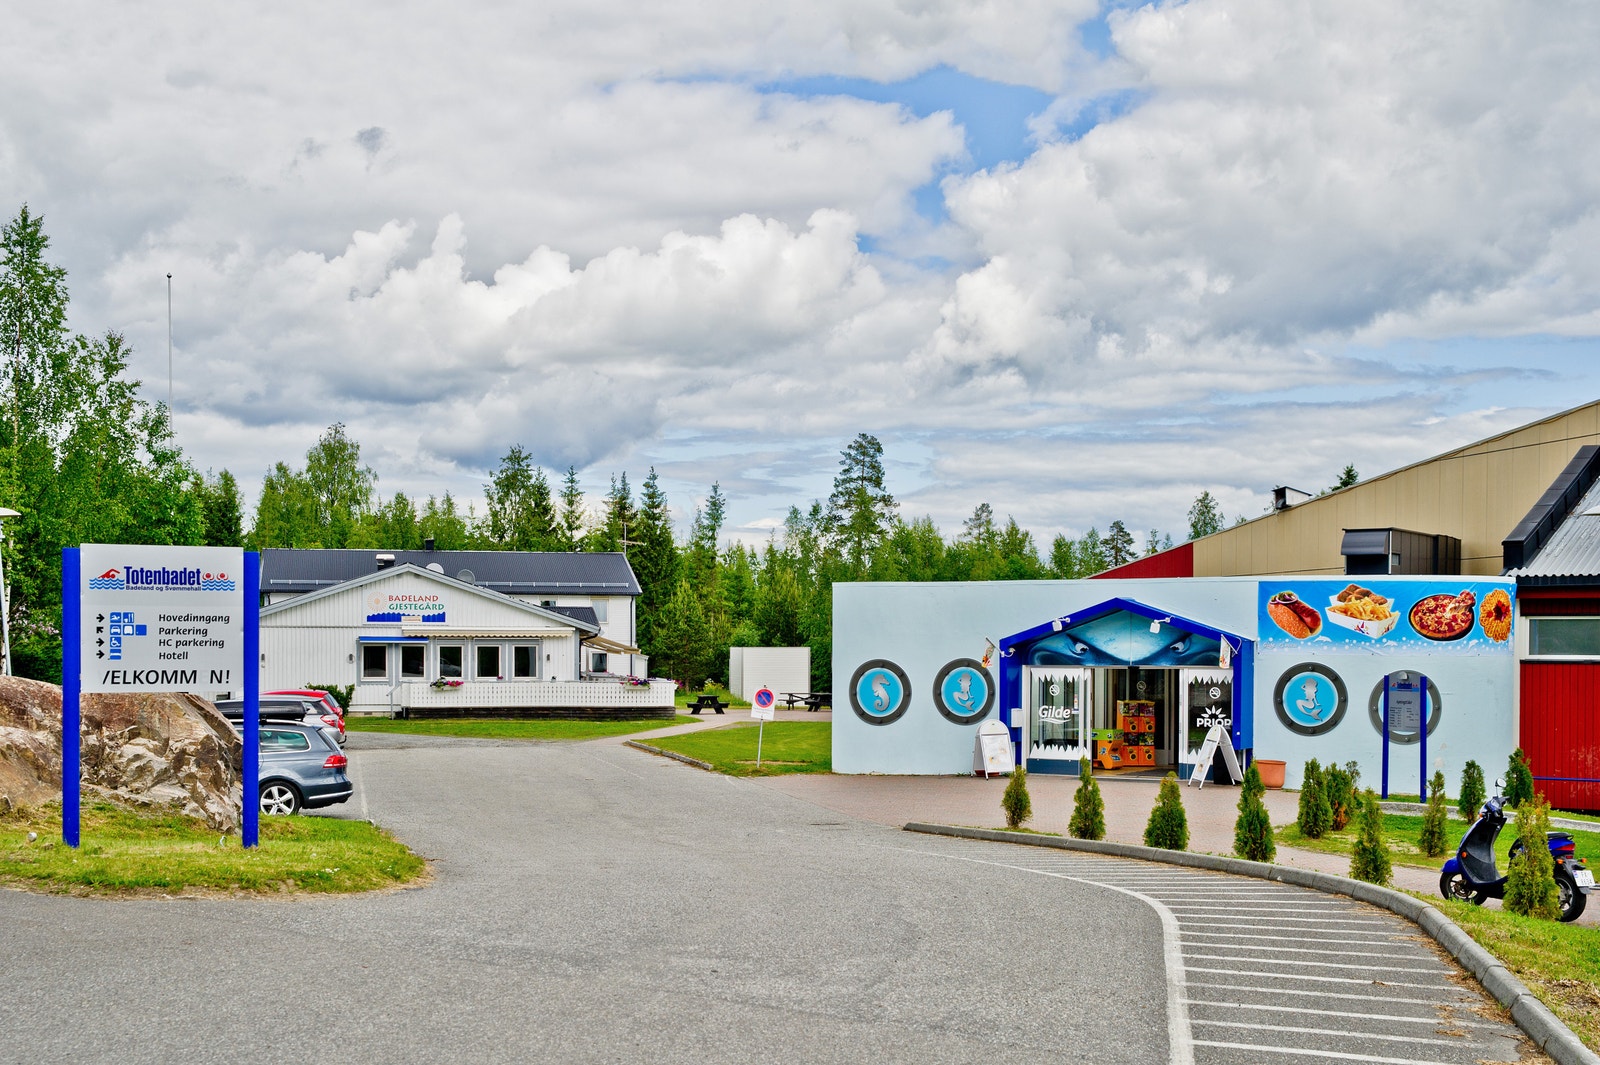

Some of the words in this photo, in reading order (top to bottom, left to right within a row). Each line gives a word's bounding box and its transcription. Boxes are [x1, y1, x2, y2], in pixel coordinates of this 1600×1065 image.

[124, 566, 201, 585] Totenbadet
[388, 594, 439, 602] BADELAND
[388, 602, 444, 611] GJESTEGÅRD
[158, 613, 230, 624] Hovedinngang
[158, 627, 208, 637] Parkering
[158, 638, 172, 647] HC
[175, 638, 225, 649] parkering
[158, 651, 188, 660] Hotell
[102, 669, 230, 685] ELKOMMN!
[1038, 705, 1071, 718] Gilde
